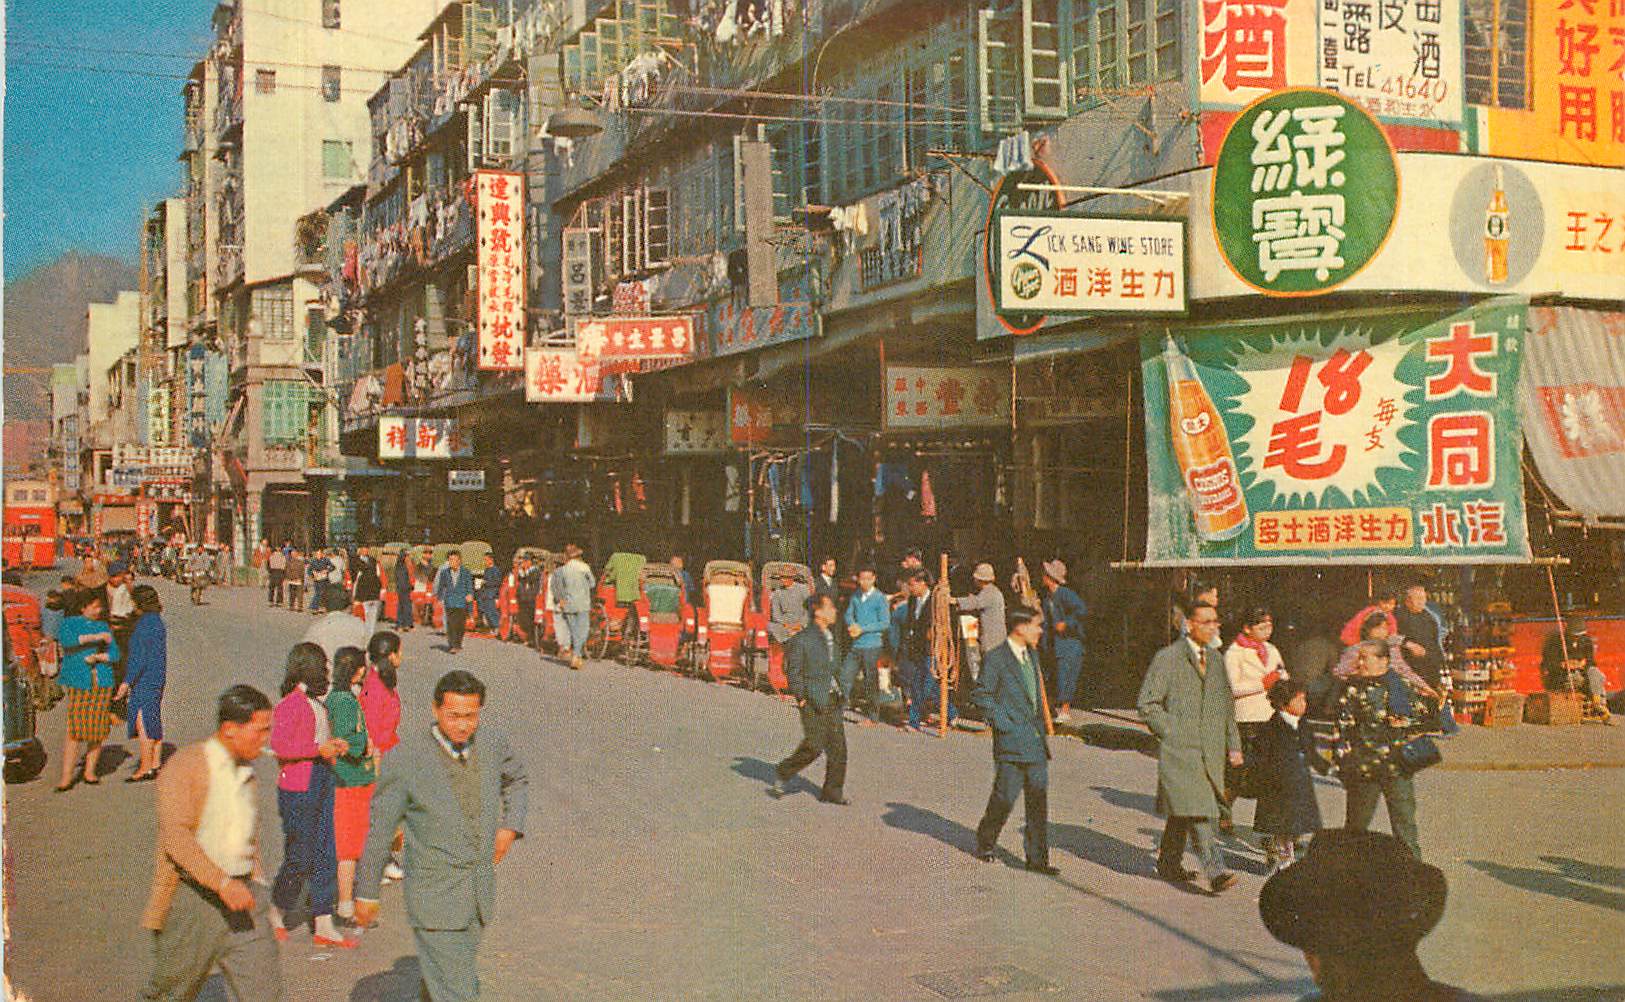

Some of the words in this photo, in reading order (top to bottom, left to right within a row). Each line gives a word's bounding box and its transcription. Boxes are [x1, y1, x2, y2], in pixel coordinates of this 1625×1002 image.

[1381, 75, 1448, 103] 41640
[1072, 235, 1101, 253] SANG
[1108, 236, 1132, 254] WINE
[1141, 237, 1174, 256] STORE
[1263, 410, 1347, 480] 毛
